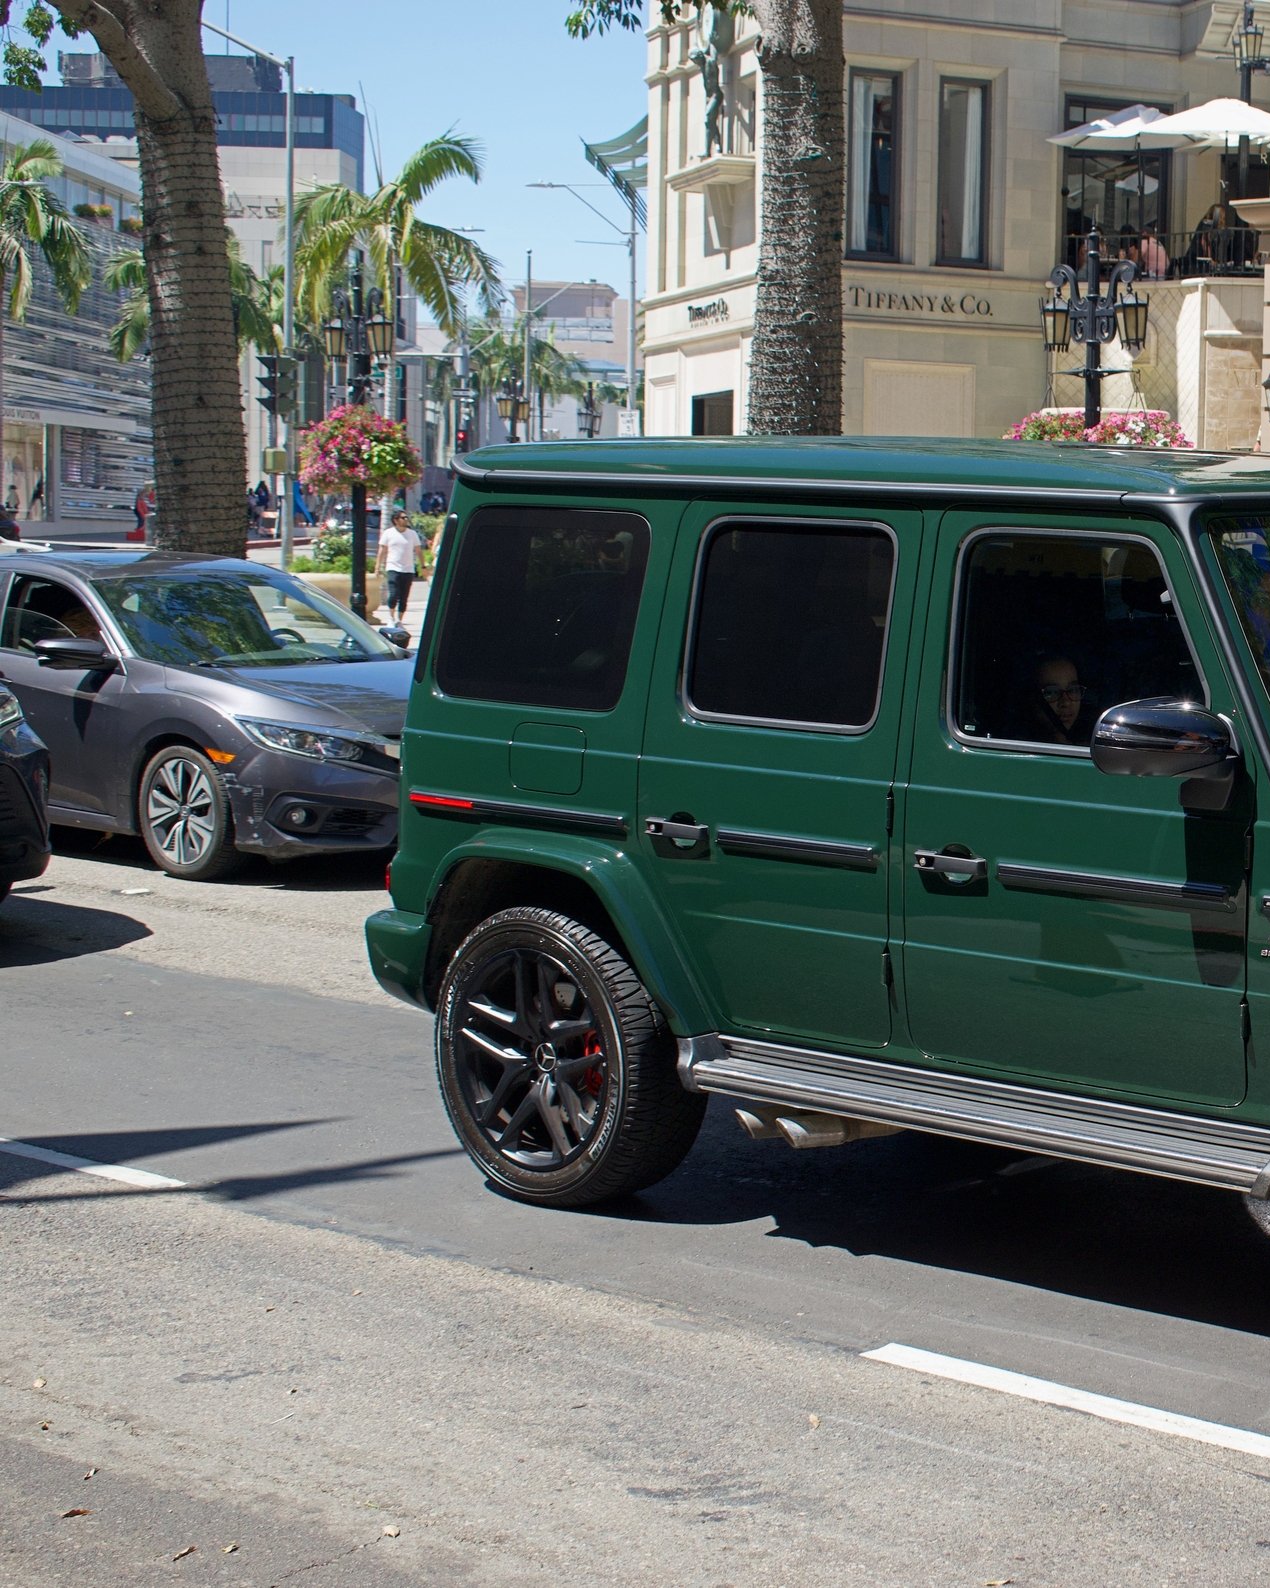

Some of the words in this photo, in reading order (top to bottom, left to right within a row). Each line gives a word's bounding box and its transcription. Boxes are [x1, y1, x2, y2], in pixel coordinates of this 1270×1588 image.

[849, 286, 937, 312] TIFFANY
[941, 294, 955, 313] &
[590, 1102, 616, 1160] MICHELIN
